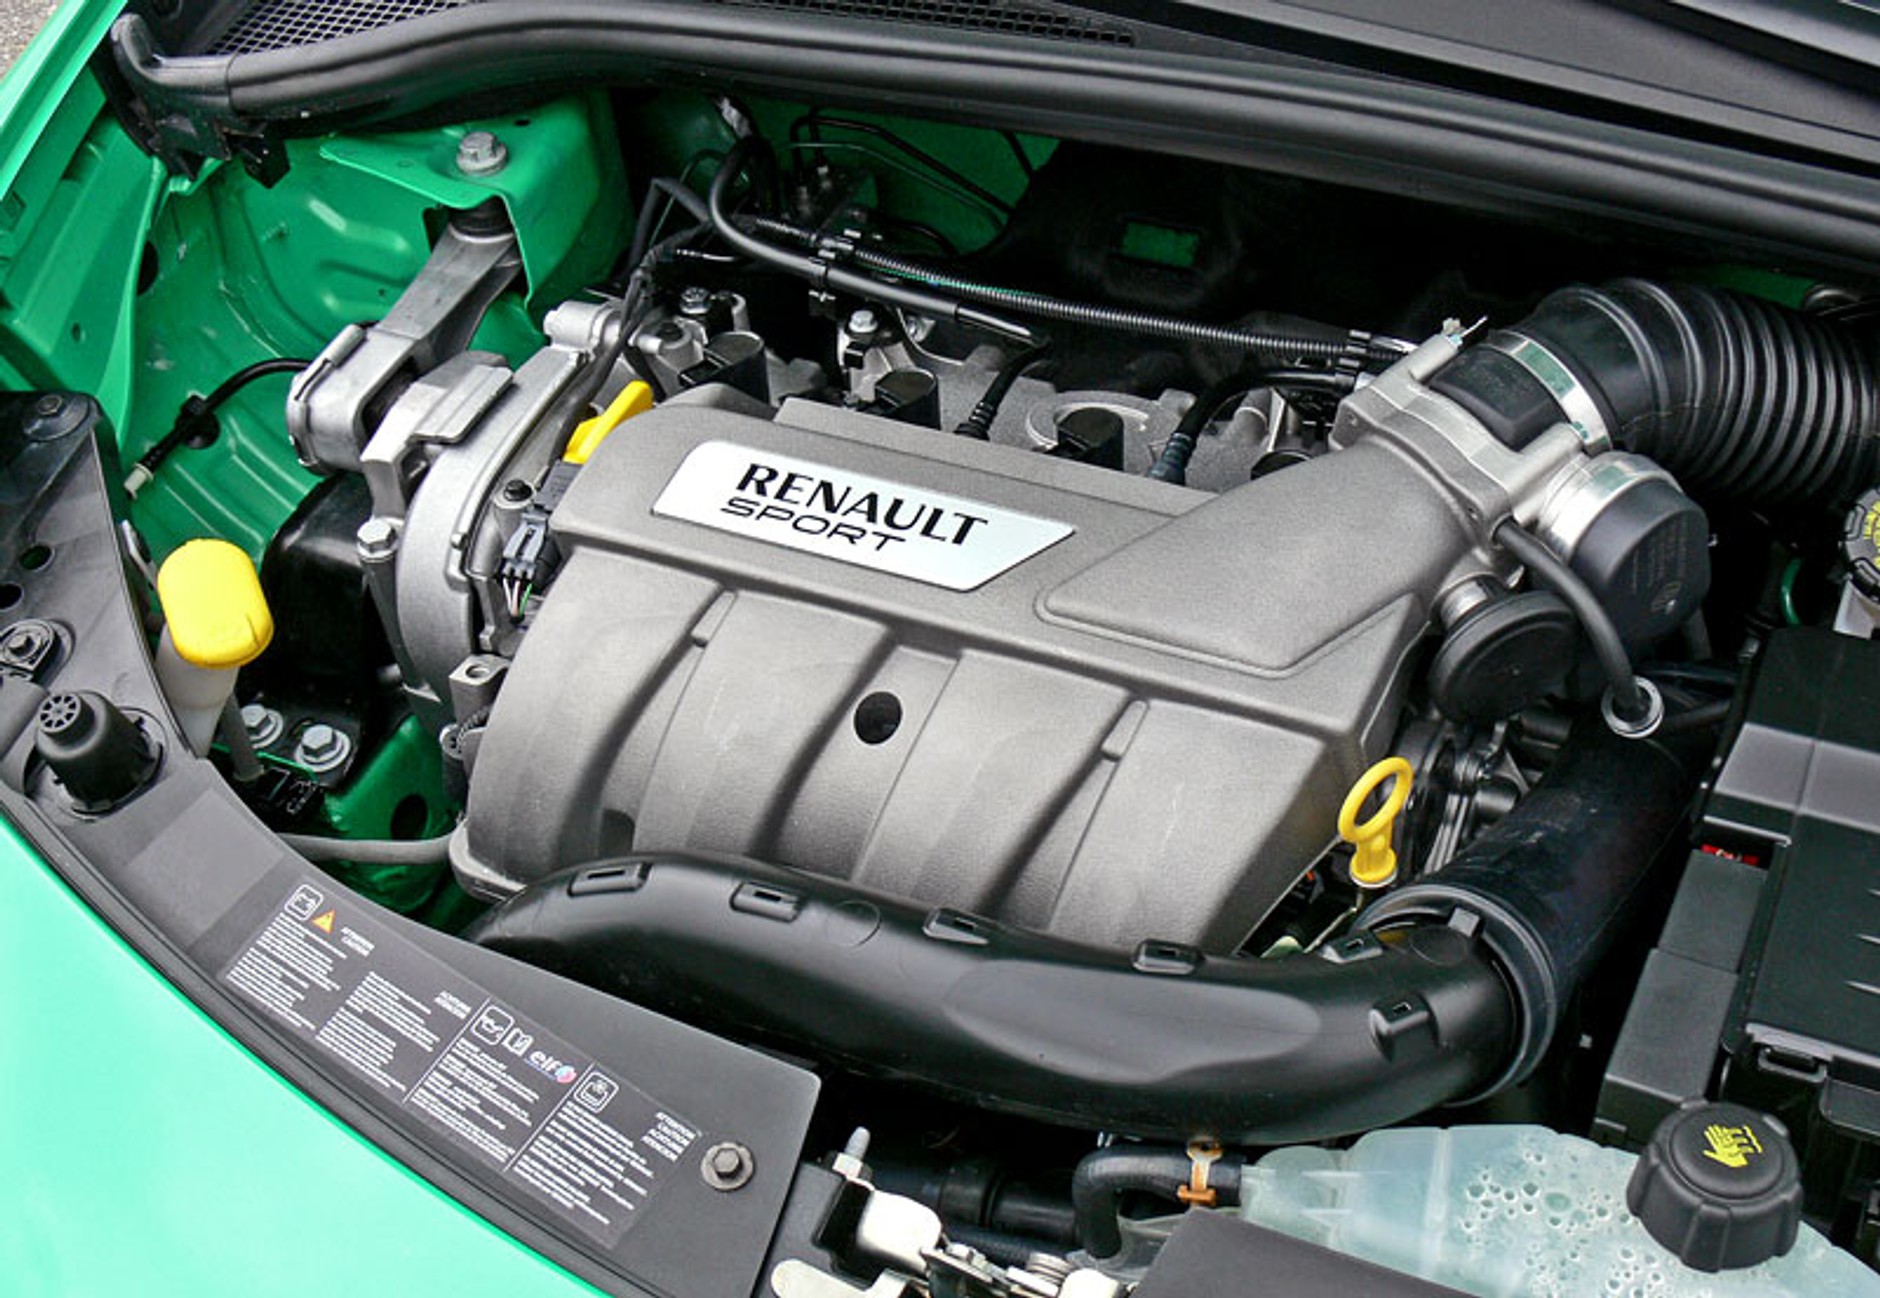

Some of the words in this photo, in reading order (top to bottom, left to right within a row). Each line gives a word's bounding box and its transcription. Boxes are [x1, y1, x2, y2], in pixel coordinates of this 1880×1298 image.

[721, 497, 905, 551] SPORT
[735, 463, 988, 546] RENAULT
[529, 1051, 563, 1072] elf
